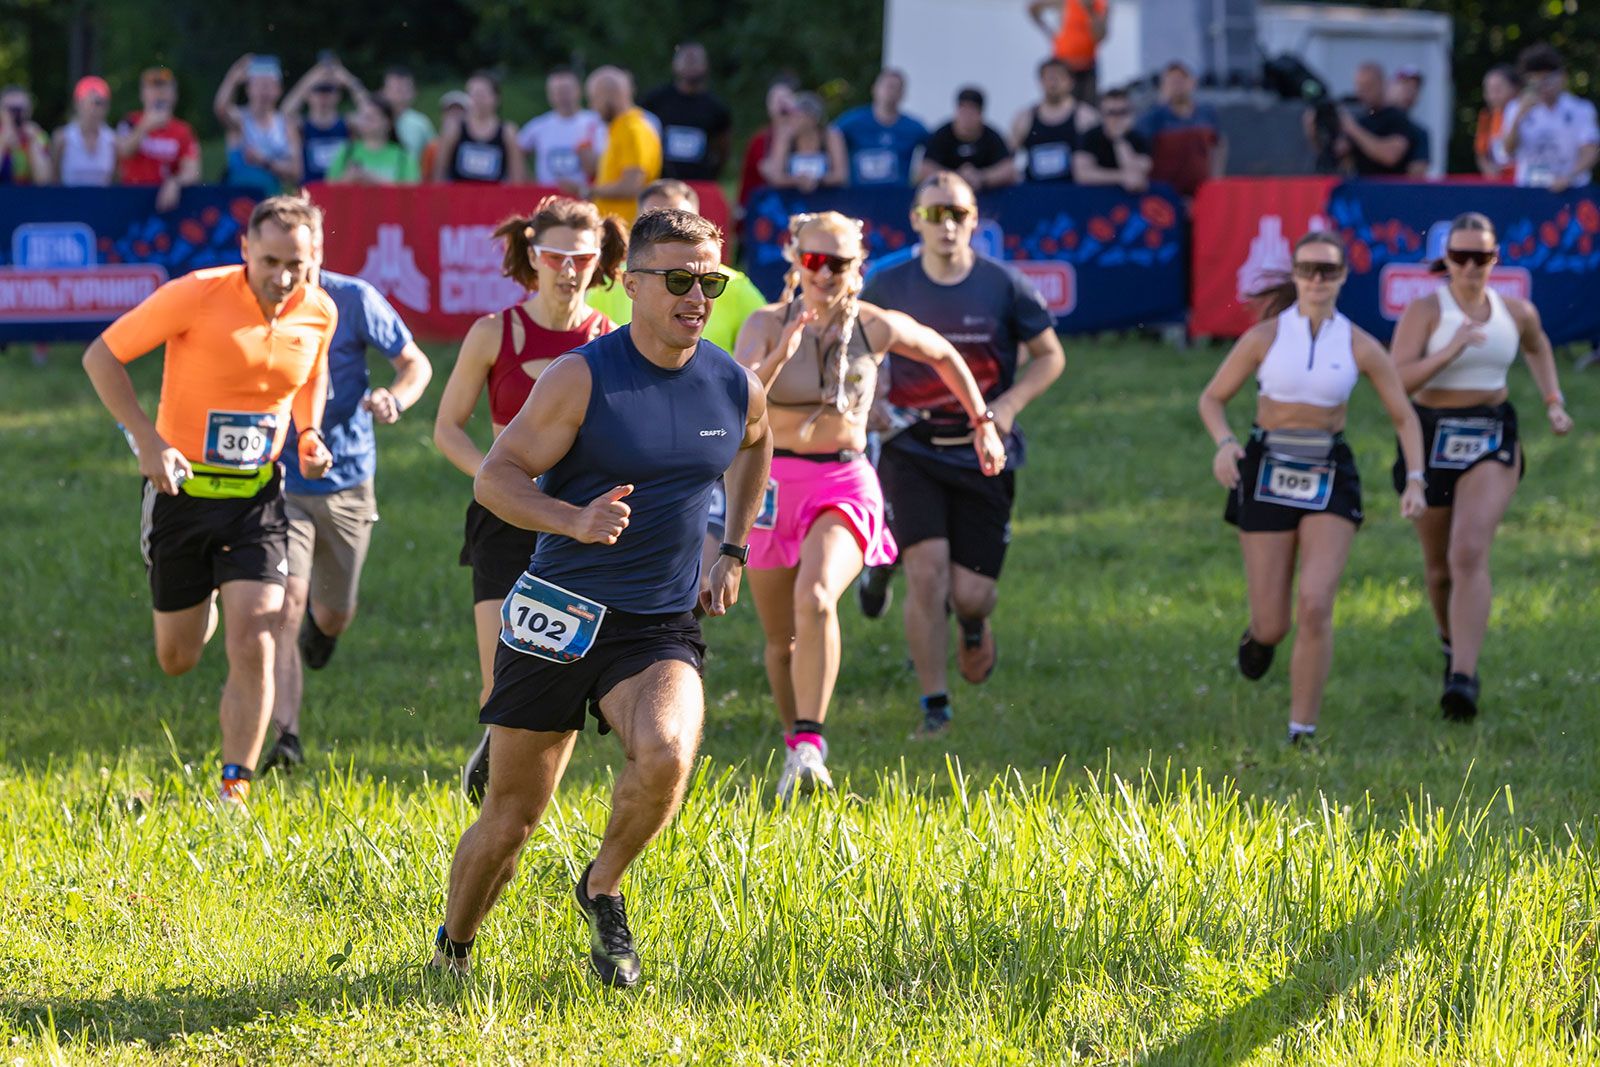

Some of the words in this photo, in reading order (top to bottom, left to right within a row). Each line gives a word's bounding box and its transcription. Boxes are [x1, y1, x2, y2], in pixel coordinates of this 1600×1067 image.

[223, 434, 261, 451] 300
[1278, 472, 1312, 492] 105
[517, 606, 567, 642] 102
